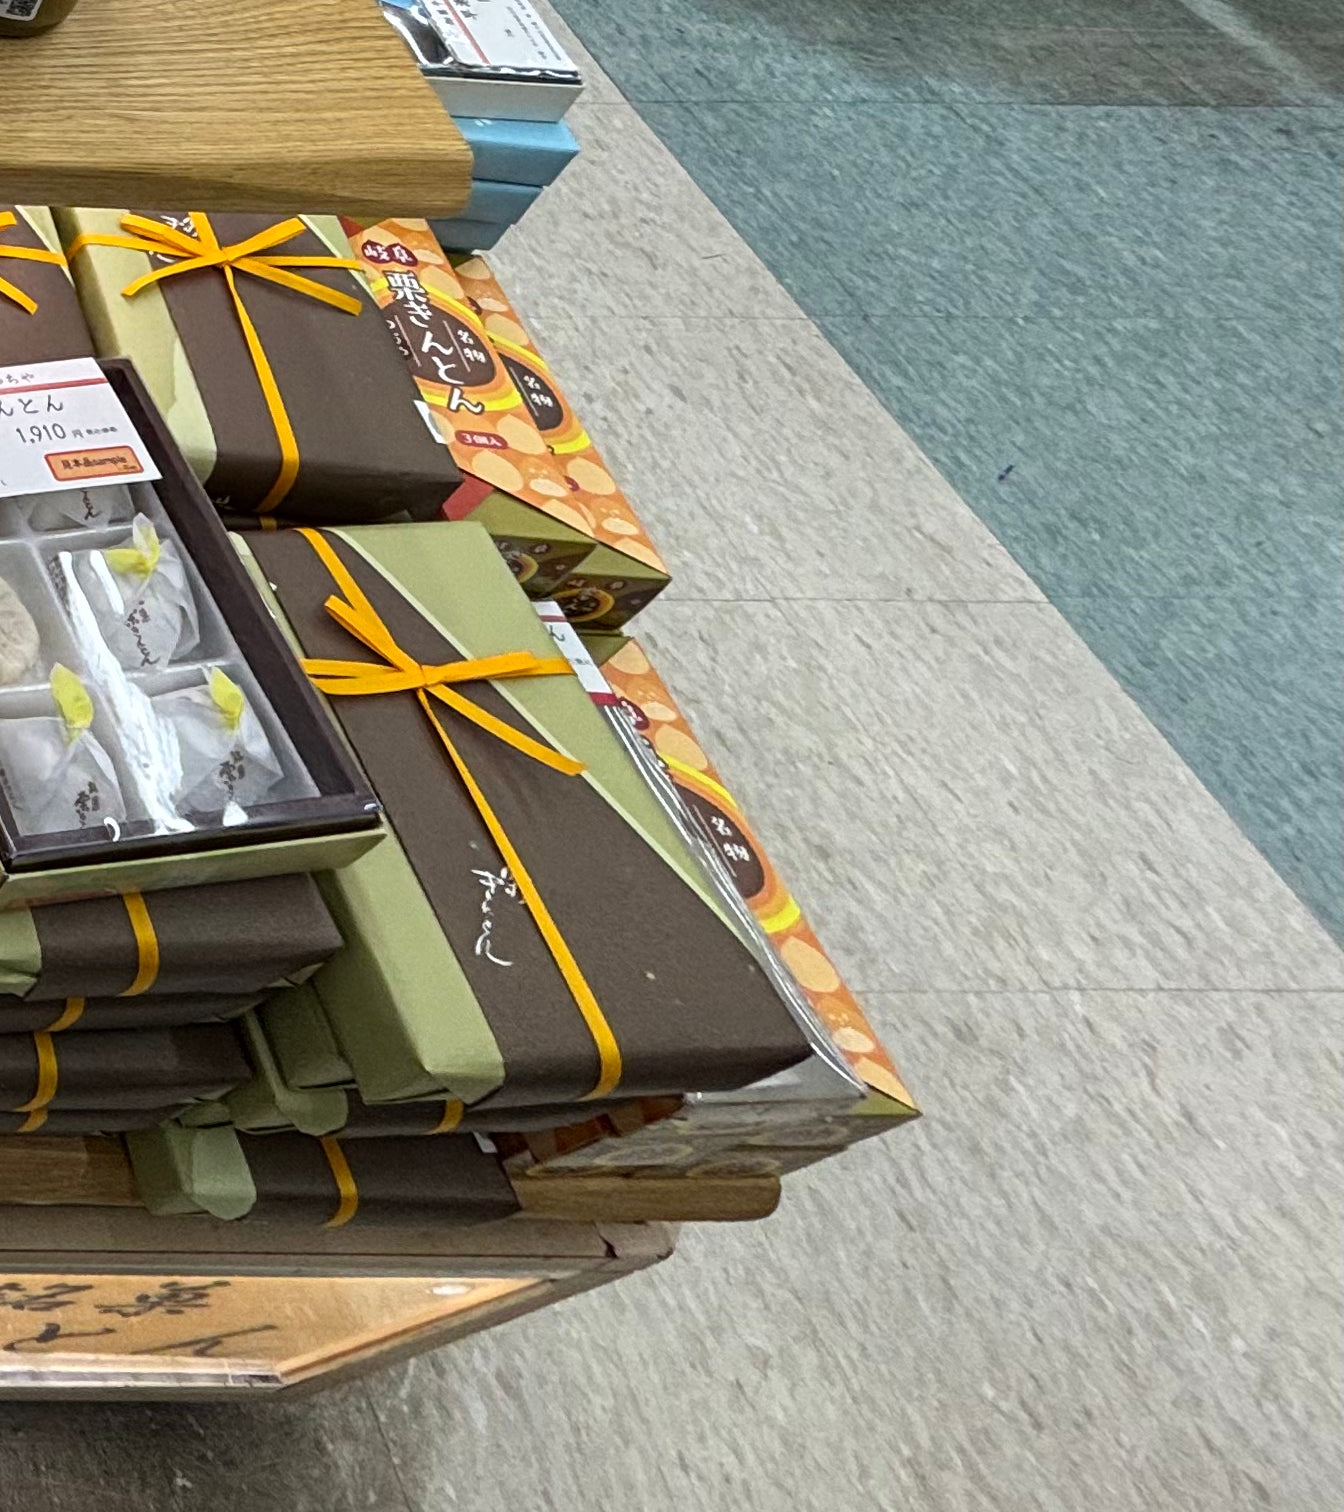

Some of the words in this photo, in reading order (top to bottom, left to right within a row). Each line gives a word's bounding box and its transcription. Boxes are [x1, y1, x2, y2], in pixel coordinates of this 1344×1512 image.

[363, 243, 413, 263] 岐阜
[383, 270, 485, 415] 栗きんとん
[456, 329, 487, 364] 名物
[522, 374, 554, 408] 名物
[15, 422, 67, 445] 1,910
[462, 433, 502, 447] 3個入
[709, 815, 750, 863] 名物
